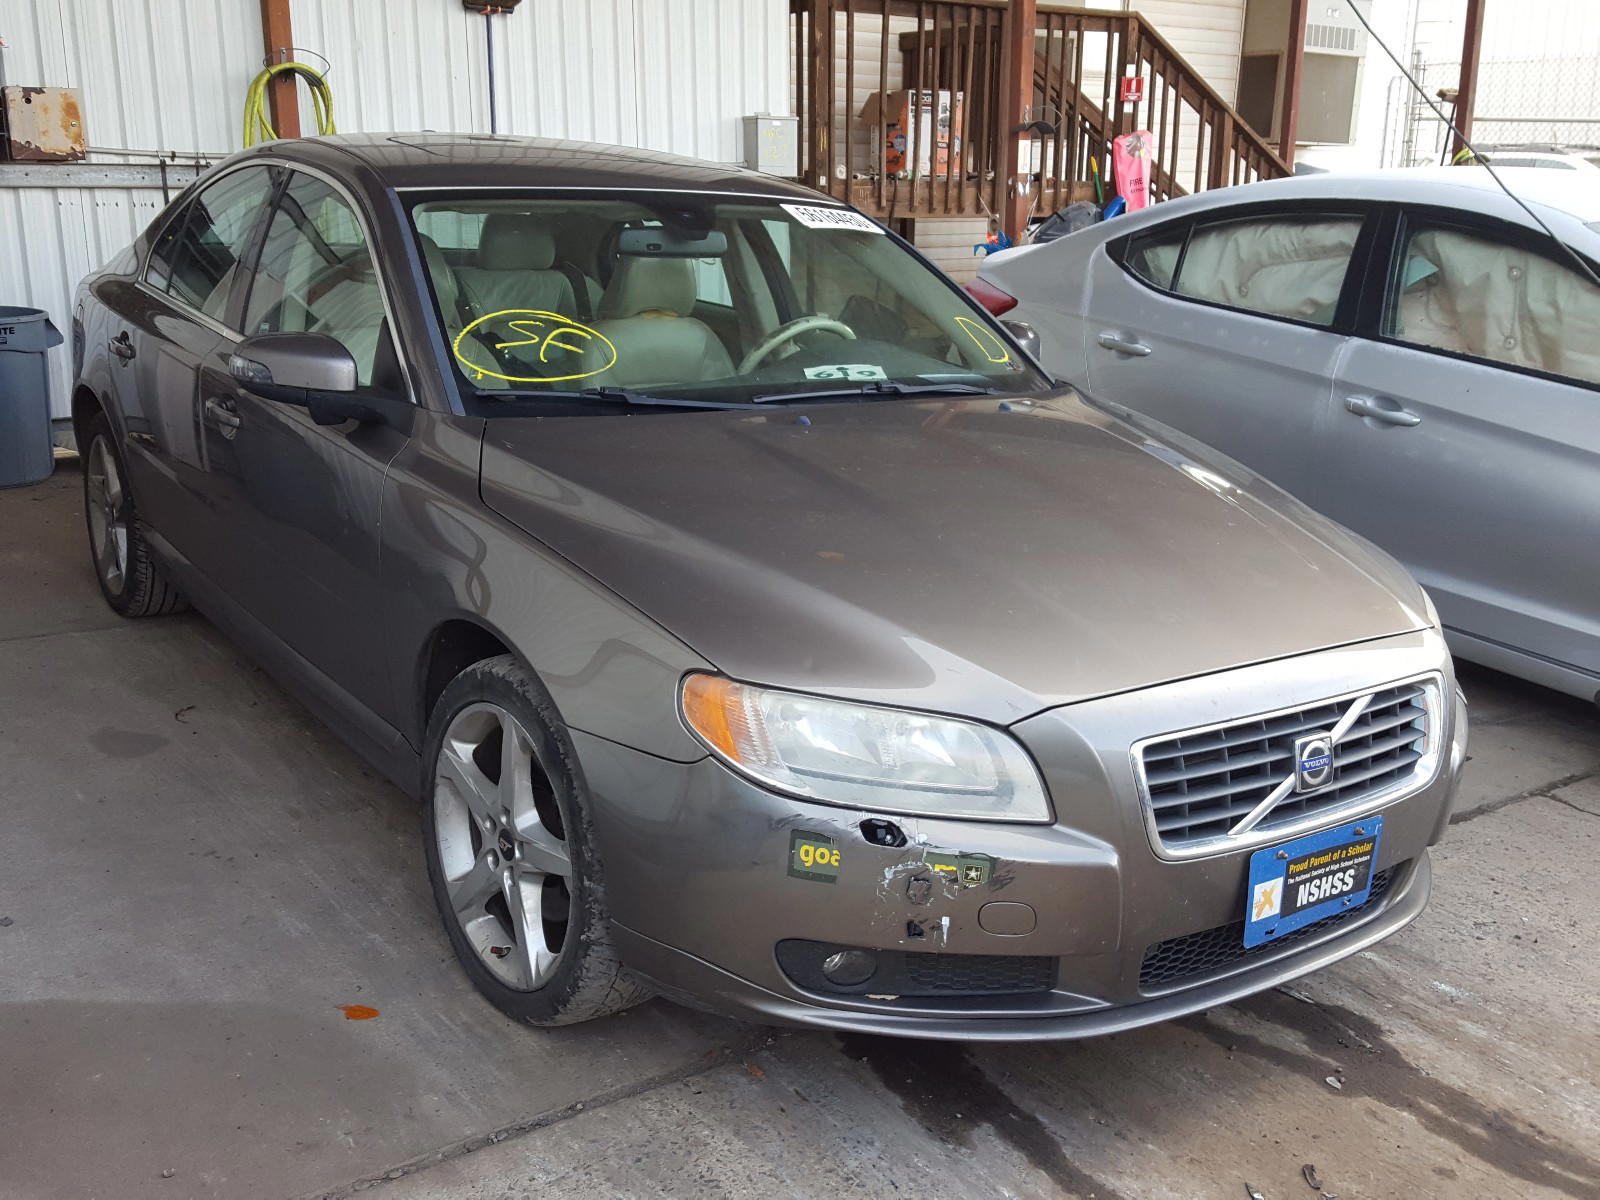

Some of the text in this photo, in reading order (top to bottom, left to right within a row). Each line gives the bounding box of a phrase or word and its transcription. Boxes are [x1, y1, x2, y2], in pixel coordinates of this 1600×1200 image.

[1129, 177, 1144, 187] FIRE
[495, 319, 593, 364] SF
[1303, 757, 1330, 769] VOLVO
[1289, 859, 1308, 874] Proud
[1309, 853, 1331, 867] Parent
[1333, 850, 1341, 860] of
[1347, 843, 1373, 856] Scholar
[1296, 869, 1354, 907] NSHSS
